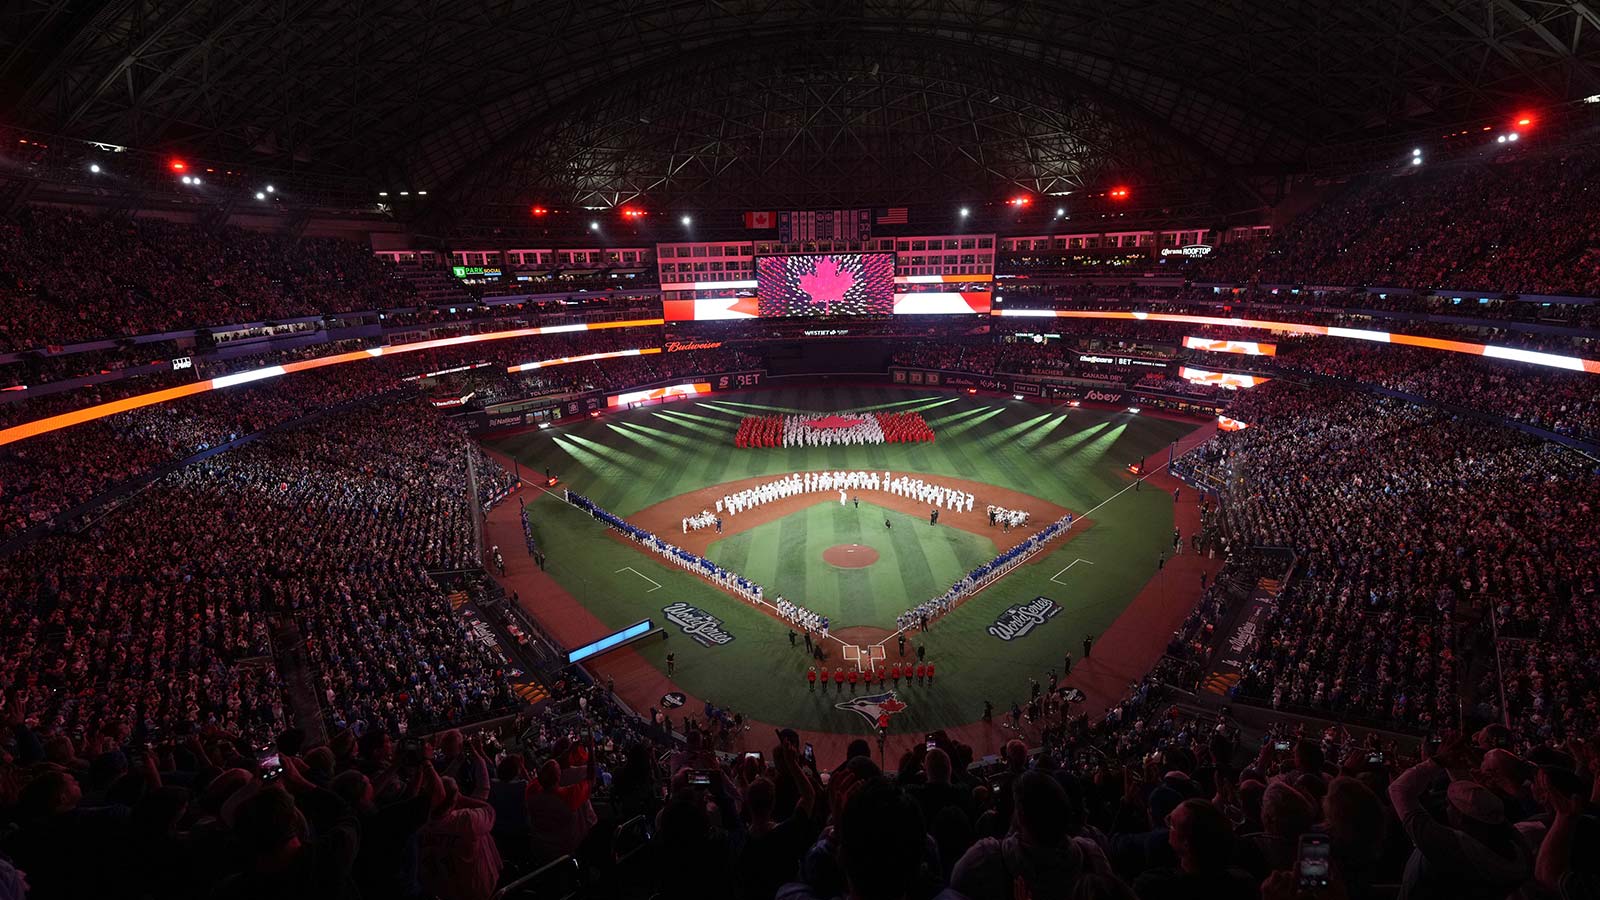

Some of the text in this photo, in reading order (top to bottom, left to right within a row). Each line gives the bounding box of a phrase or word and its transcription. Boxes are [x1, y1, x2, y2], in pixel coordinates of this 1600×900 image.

[1161, 247, 1212, 257] Corona ROOFTOP
[664, 341, 723, 353] Budweiser
[736, 373, 761, 386] BET
[1082, 372, 1109, 380] CANADA
[1083, 390, 1122, 403] Sobeys
[496, 415, 522, 426] National
[664, 603, 704, 627] World
[989, 610, 1031, 640] World
[1018, 597, 1054, 625] Series
[683, 621, 733, 645] Series
